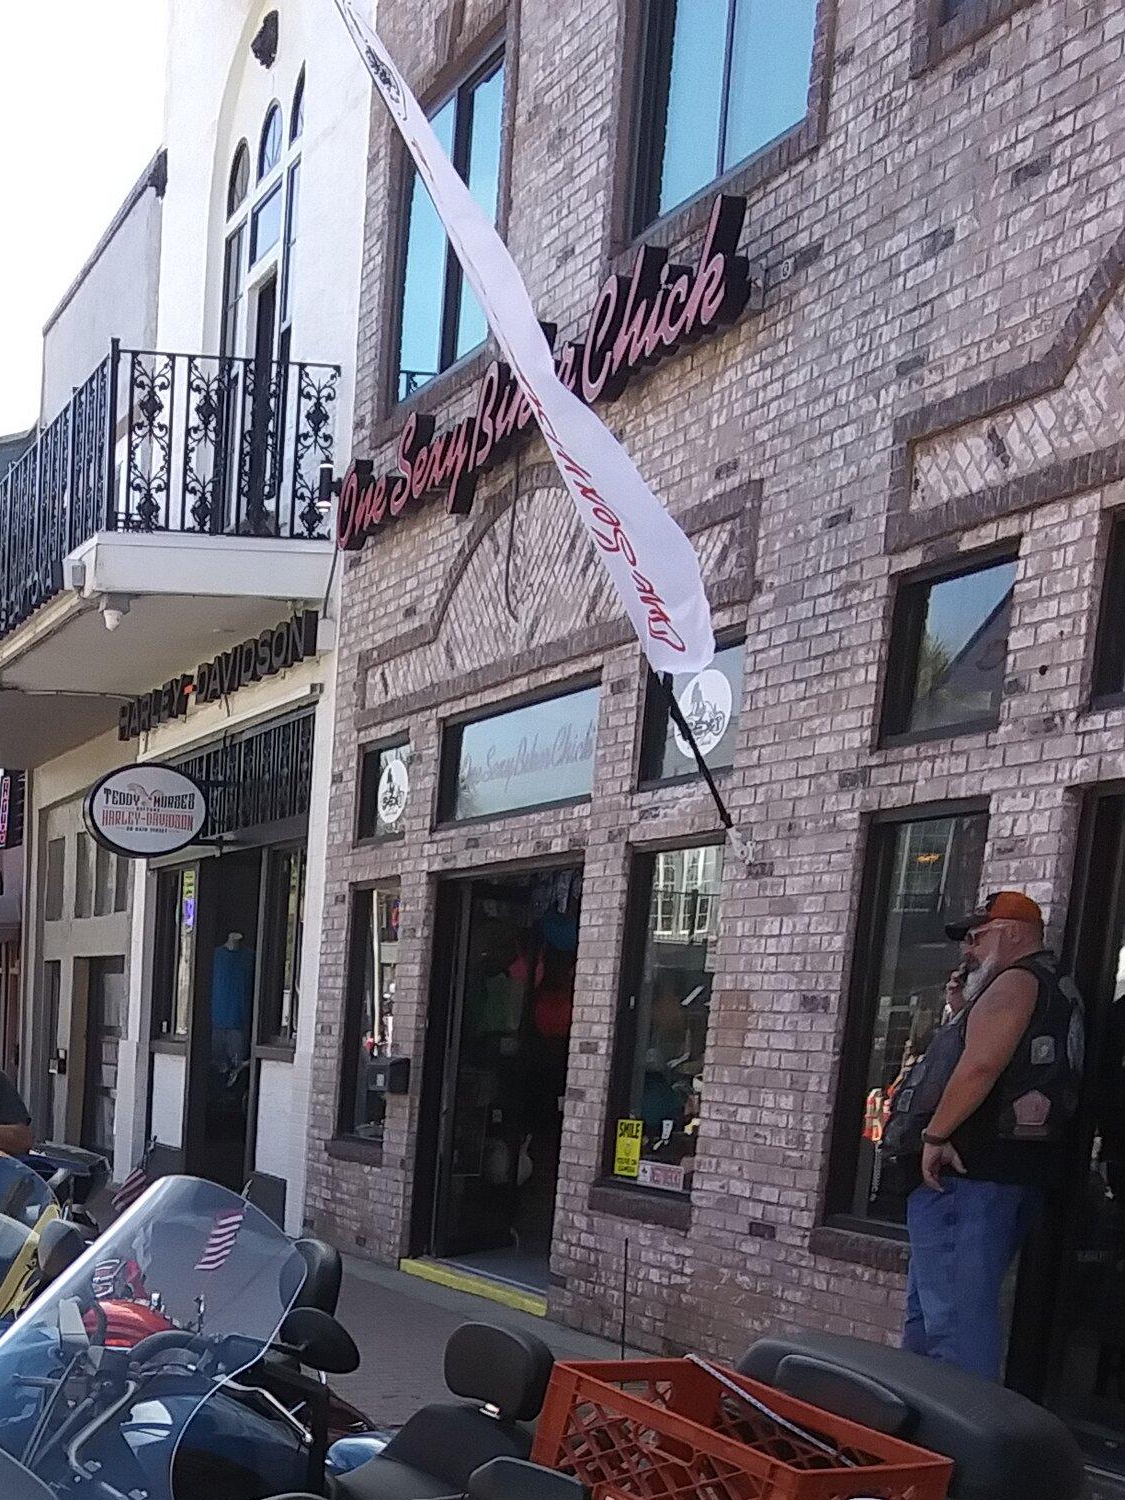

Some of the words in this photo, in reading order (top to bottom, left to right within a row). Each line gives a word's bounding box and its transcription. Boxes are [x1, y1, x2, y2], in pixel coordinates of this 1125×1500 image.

[336, 460, 386, 550] One
[389, 412, 474, 515] Sexy
[583, 194, 728, 403] Chick
[118, 609, 319, 741] HARLEY-DAVIDSON
[104, 788, 140, 806] TEDDY
[102, 809, 194, 832] HARLEY-DAVIDSON
[619, 1121, 641, 1139] SMILE
